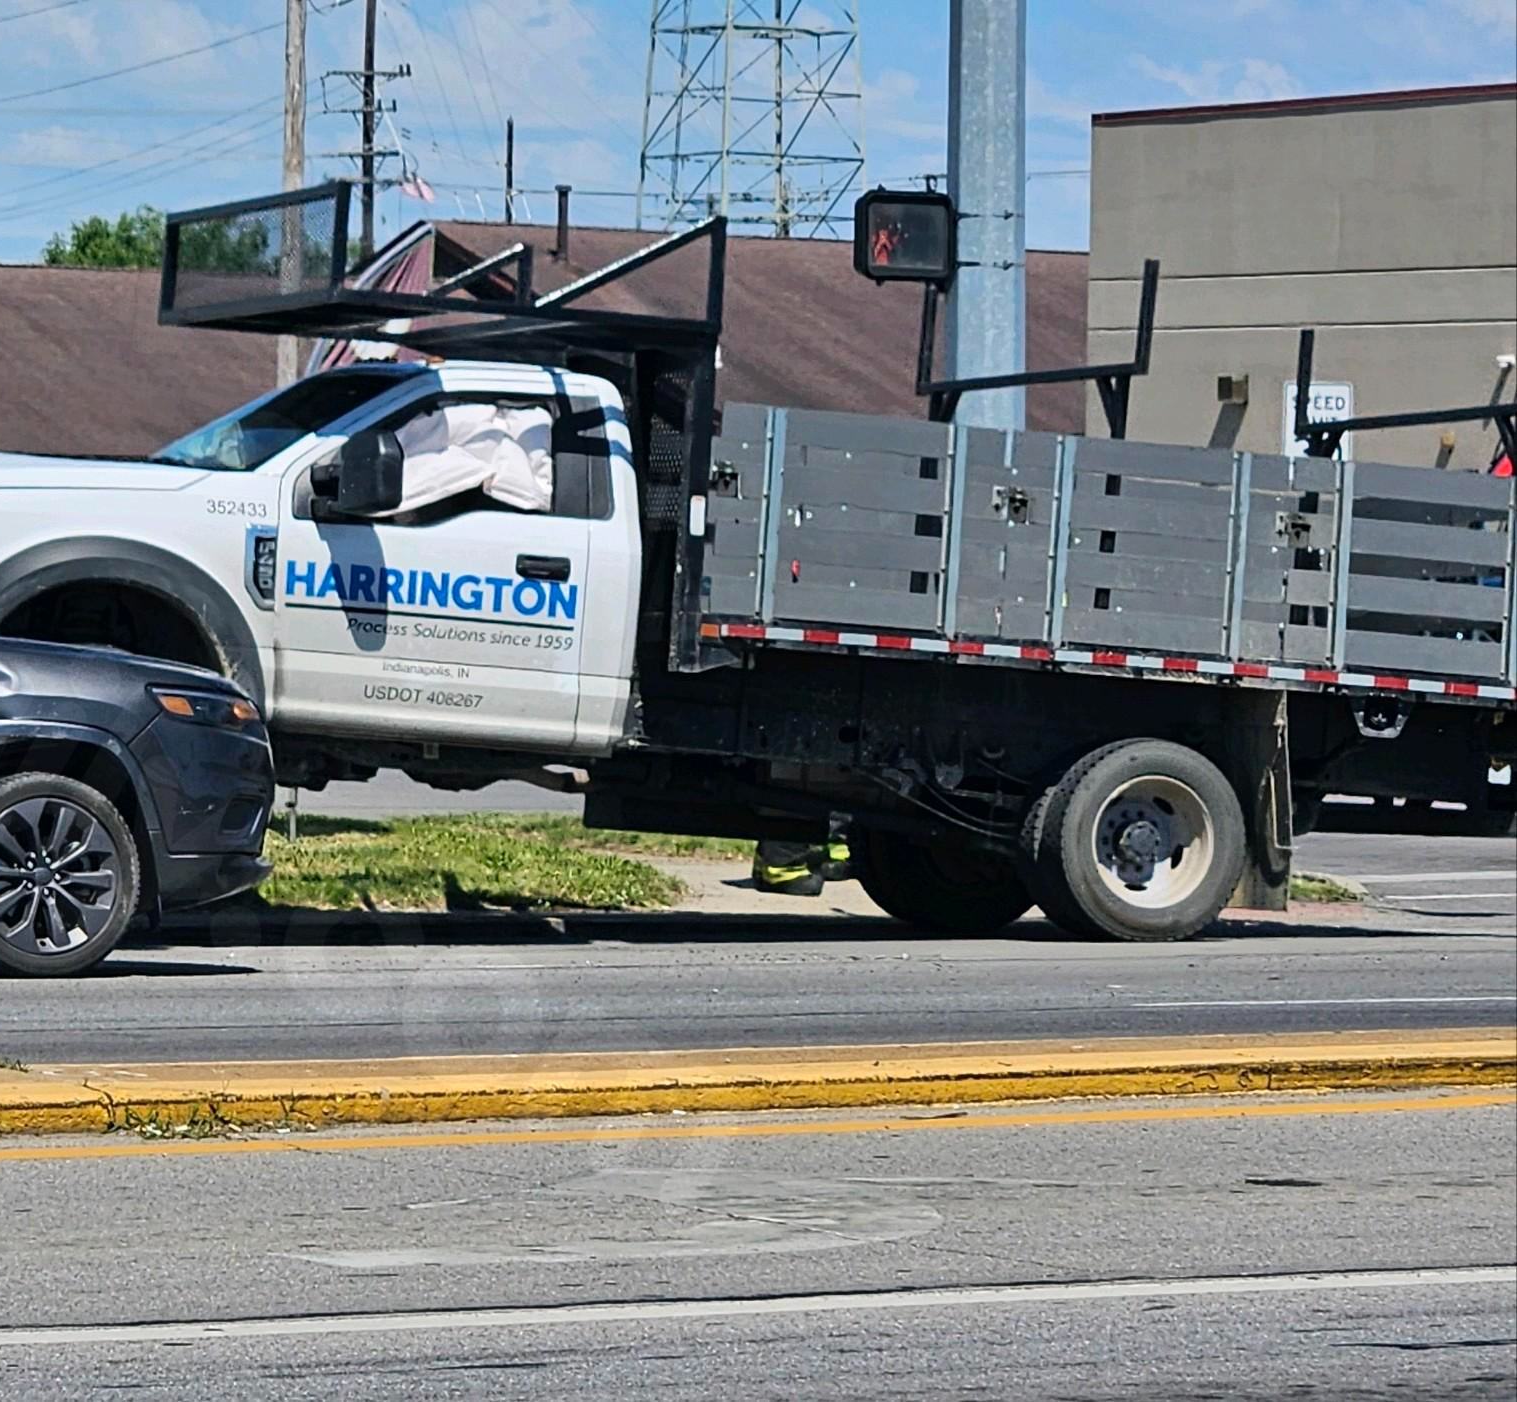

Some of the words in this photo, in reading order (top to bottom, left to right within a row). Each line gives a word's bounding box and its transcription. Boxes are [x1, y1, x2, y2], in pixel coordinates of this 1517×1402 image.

[206, 498, 267, 517] 352433
[285, 559, 578, 620] HARRINGTON
[347, 617, 408, 637] Process
[413, 622, 486, 643] Solutions
[490, 631, 531, 647] since
[534, 633, 574, 651] 1959
[382, 661, 454, 678] Indianapolis,
[457, 667, 470, 678] IN
[364, 684, 423, 703] USDOT
